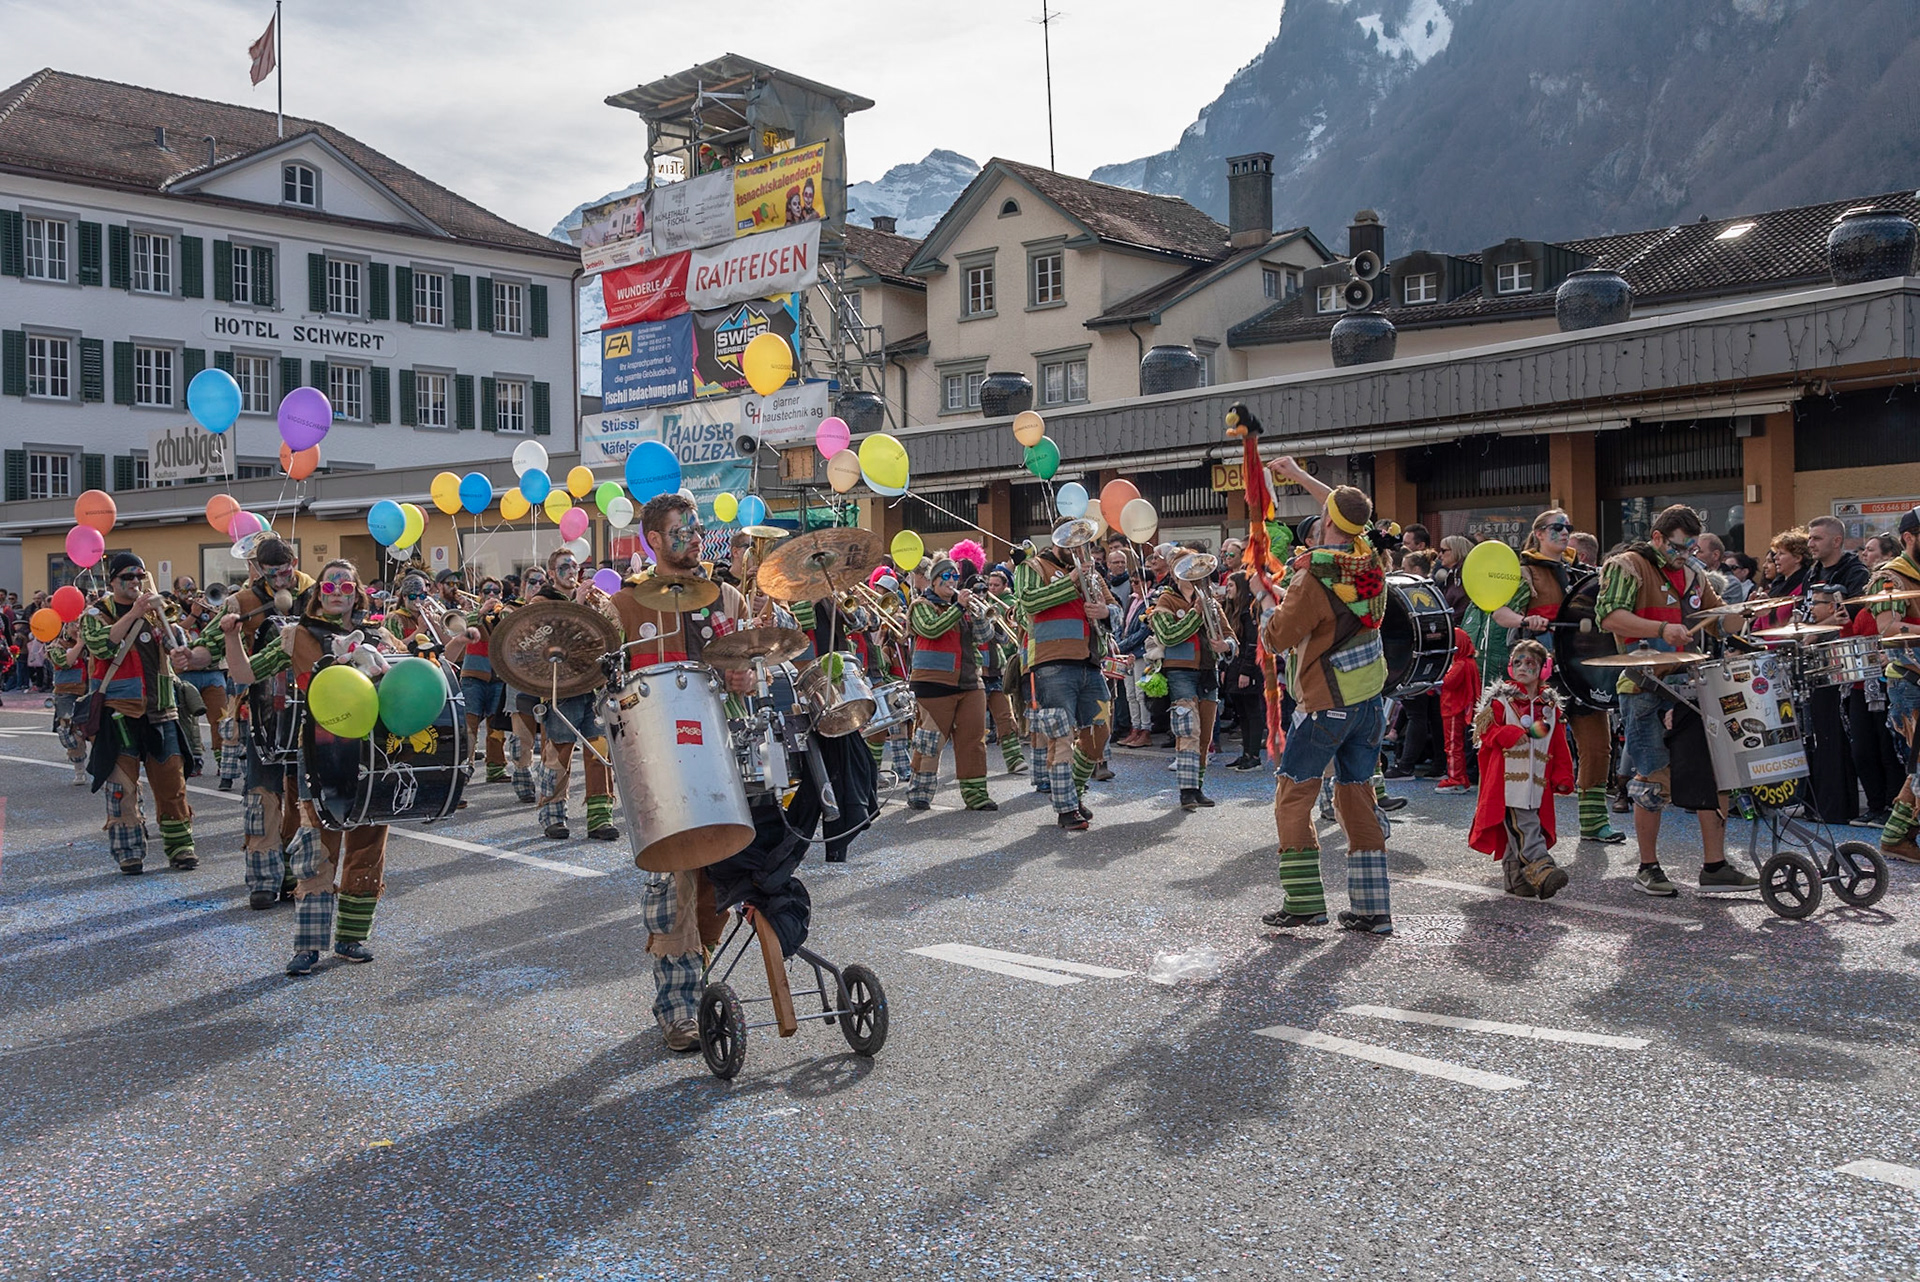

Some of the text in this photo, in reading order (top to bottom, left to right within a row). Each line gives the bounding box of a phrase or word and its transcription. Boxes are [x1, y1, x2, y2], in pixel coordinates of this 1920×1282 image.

[736, 161, 822, 207] fasnachtskalender.ch
[695, 243, 808, 291] RAIFFEISEN
[617, 280, 660, 300] WUNDERLE
[662, 276, 672, 289] AG
[215, 317, 384, 350] HOTEL SCHWERT
[606, 334, 631, 356] FA
[717, 324, 767, 348] SWISS
[605, 379, 688, 405] Fischli Bedachungen AG
[773, 396, 801, 411] glarner
[601, 417, 640, 433] Stüssi
[762, 407, 824, 423] haustechnik ag
[669, 422, 735, 445] HAUSER
[155, 427, 227, 475] schubiger
[601, 439, 637, 455] Näfels
[673, 441, 740, 463] HOLZBA
[1469, 522, 1520, 534] BISTRO
